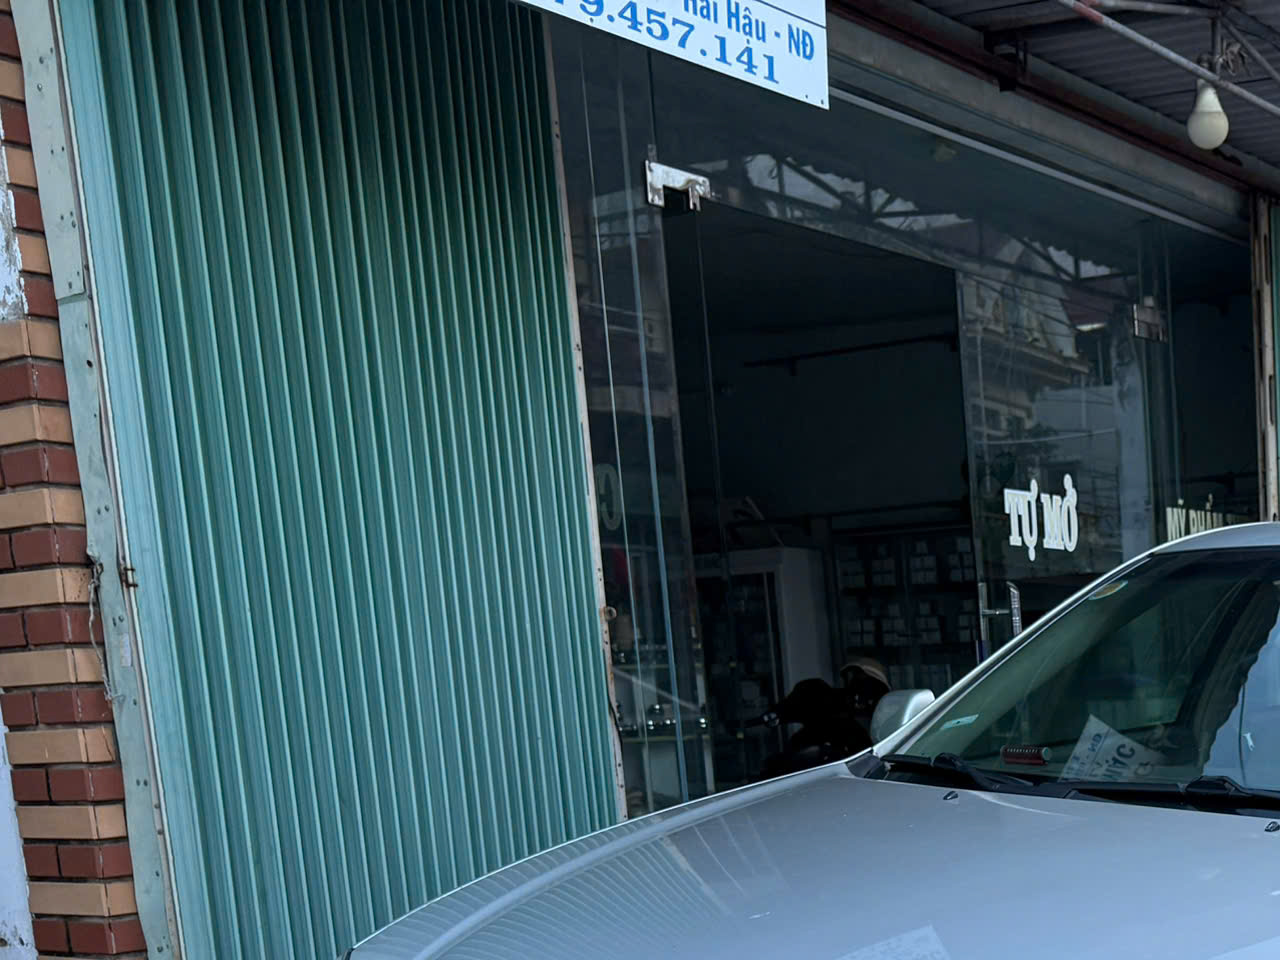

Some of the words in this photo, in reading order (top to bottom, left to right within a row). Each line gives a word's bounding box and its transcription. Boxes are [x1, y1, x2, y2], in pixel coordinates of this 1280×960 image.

[555, 0, 779, 84] 9.457.141
[727, 0, 767, 45] Hậu
[788, 23, 815, 61] NĐ
[1040, 473, 1078, 552] MỞ
